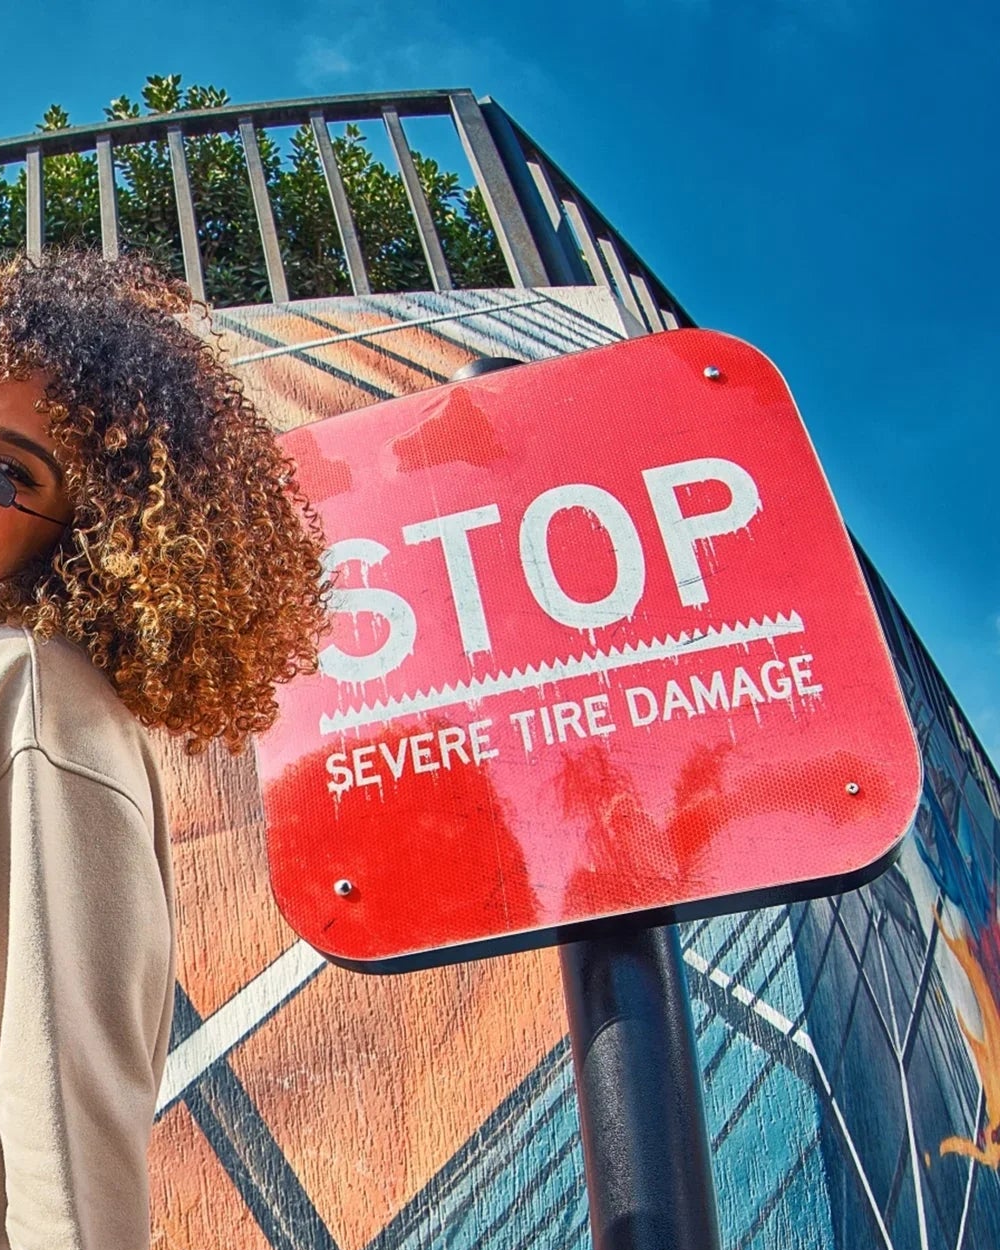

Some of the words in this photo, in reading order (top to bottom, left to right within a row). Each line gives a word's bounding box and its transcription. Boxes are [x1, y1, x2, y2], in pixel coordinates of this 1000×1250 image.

[319, 457, 762, 684] STOP
[325, 718, 500, 790] SEVERE
[509, 694, 617, 752] TIRE
[624, 653, 824, 729] DAMAGE
